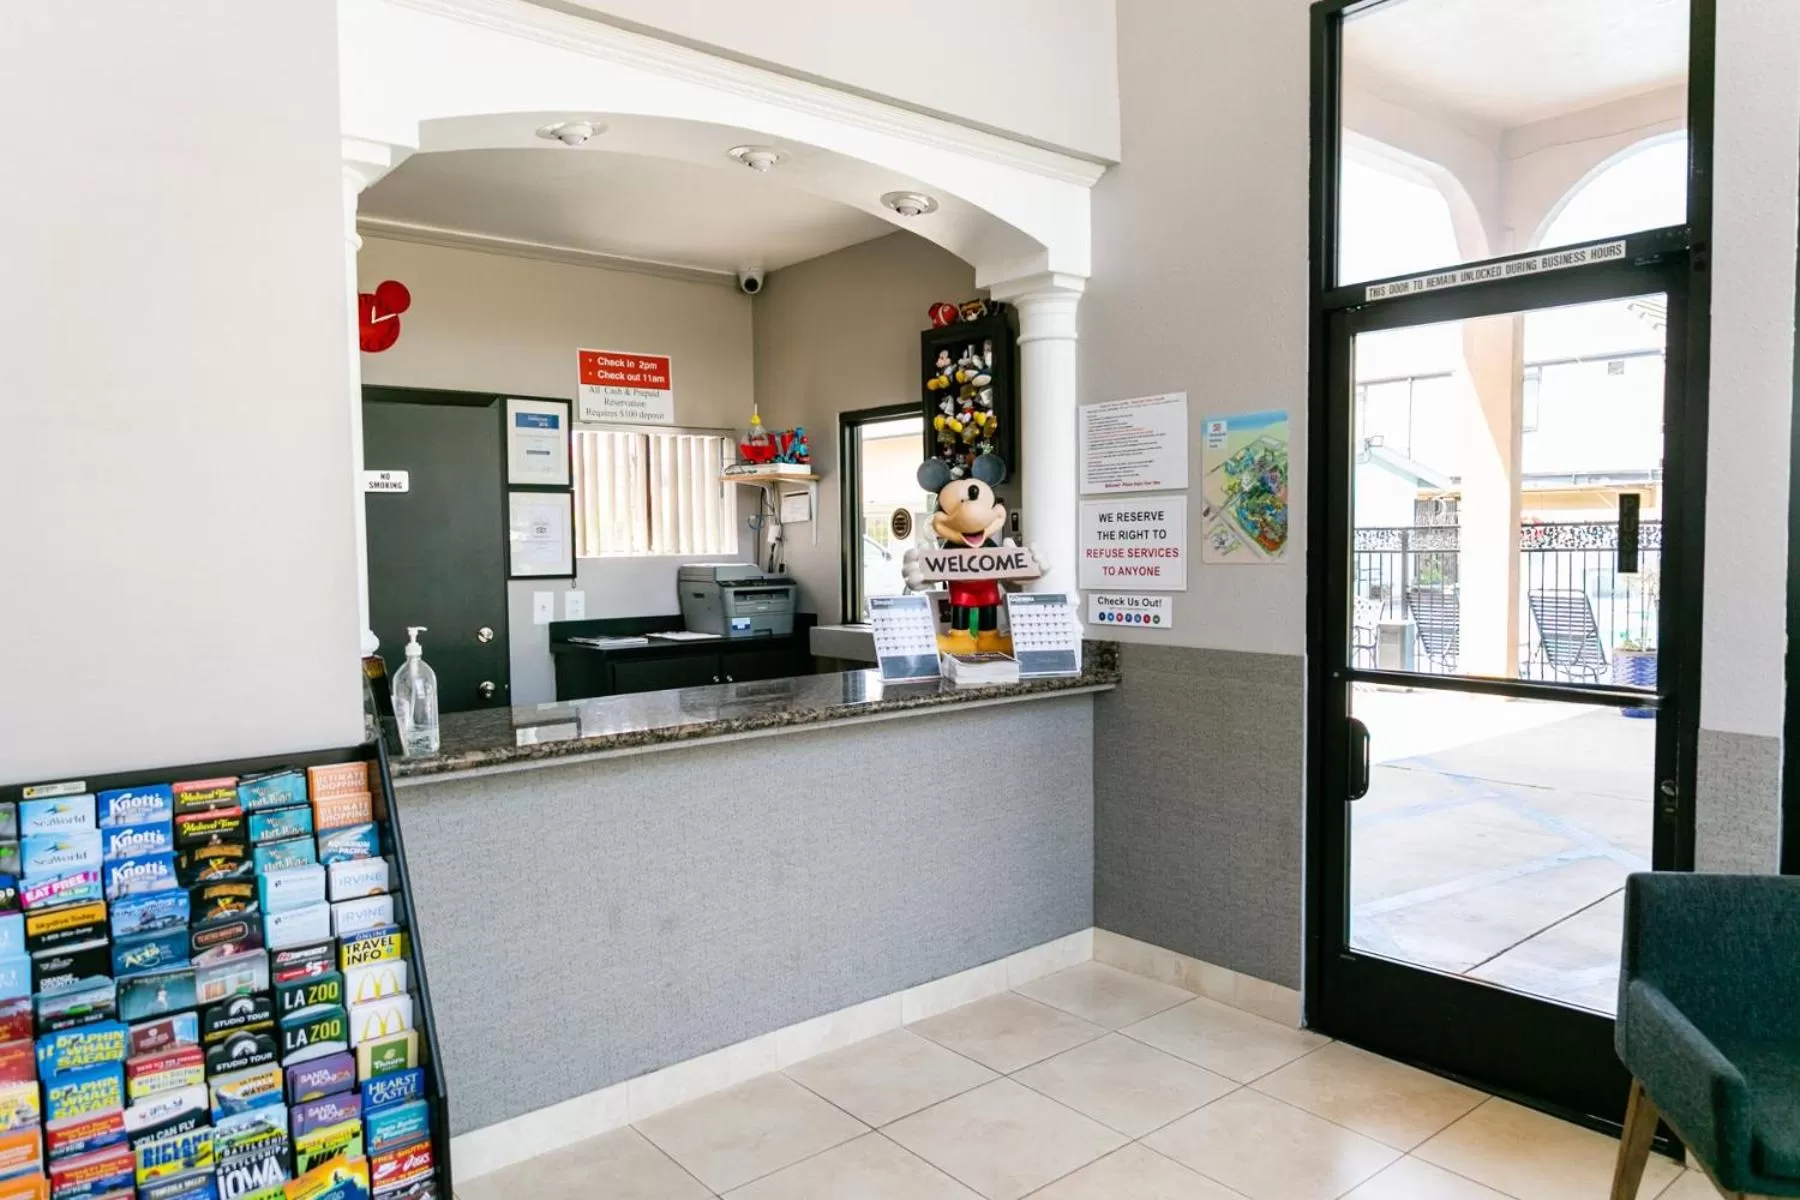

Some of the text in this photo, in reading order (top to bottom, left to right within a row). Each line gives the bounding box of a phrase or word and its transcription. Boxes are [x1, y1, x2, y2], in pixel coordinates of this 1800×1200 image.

[1369, 244, 1622, 298] THIS DOOR TO REMAIN UNLOCKED DURING BUSINESS HOURS
[597, 356, 657, 371] Check in 2pm
[597, 370, 665, 384] Check out 11am
[380, 472, 391, 480] NO
[368, 481, 403, 489] SMOKING
[1098, 511, 1164, 523] WE RESERVE
[1097, 529, 1167, 541] THE RIGHT TO
[1086, 547, 1179, 558] REFUSE SERVICES
[924, 552, 1028, 574] WELCOME
[1102, 566, 1161, 577] TO ANYONE
[1097, 596, 1163, 608] Check Us Out!
[109, 793, 164, 820] Knott's
[33, 814, 86, 827] SeaWorld
[111, 829, 165, 855] Knott's
[34, 852, 88, 866] SeaWorld
[112, 861, 168, 889] Knott's
[339, 871, 384, 888] IRVINE
[343, 907, 387, 923] IRVINE
[345, 936, 396, 956] TRAVEL
[347, 949, 382, 966] INFO
[284, 981, 338, 1010] LA ZOO
[214, 1012, 270, 1029] STUDIO TOUR
[286, 1019, 341, 1050] LA ZOO
[216, 1058, 249, 1071] STUDIO
[250, 1052, 273, 1063] TOUR
[300, 1068, 331, 1085] SANTA
[368, 1073, 419, 1096] HEARST
[372, 1085, 418, 1104] CASTLE
[308, 1103, 337, 1119] SANTA
[133, 1118, 196, 1148] YOU CAN FLY
